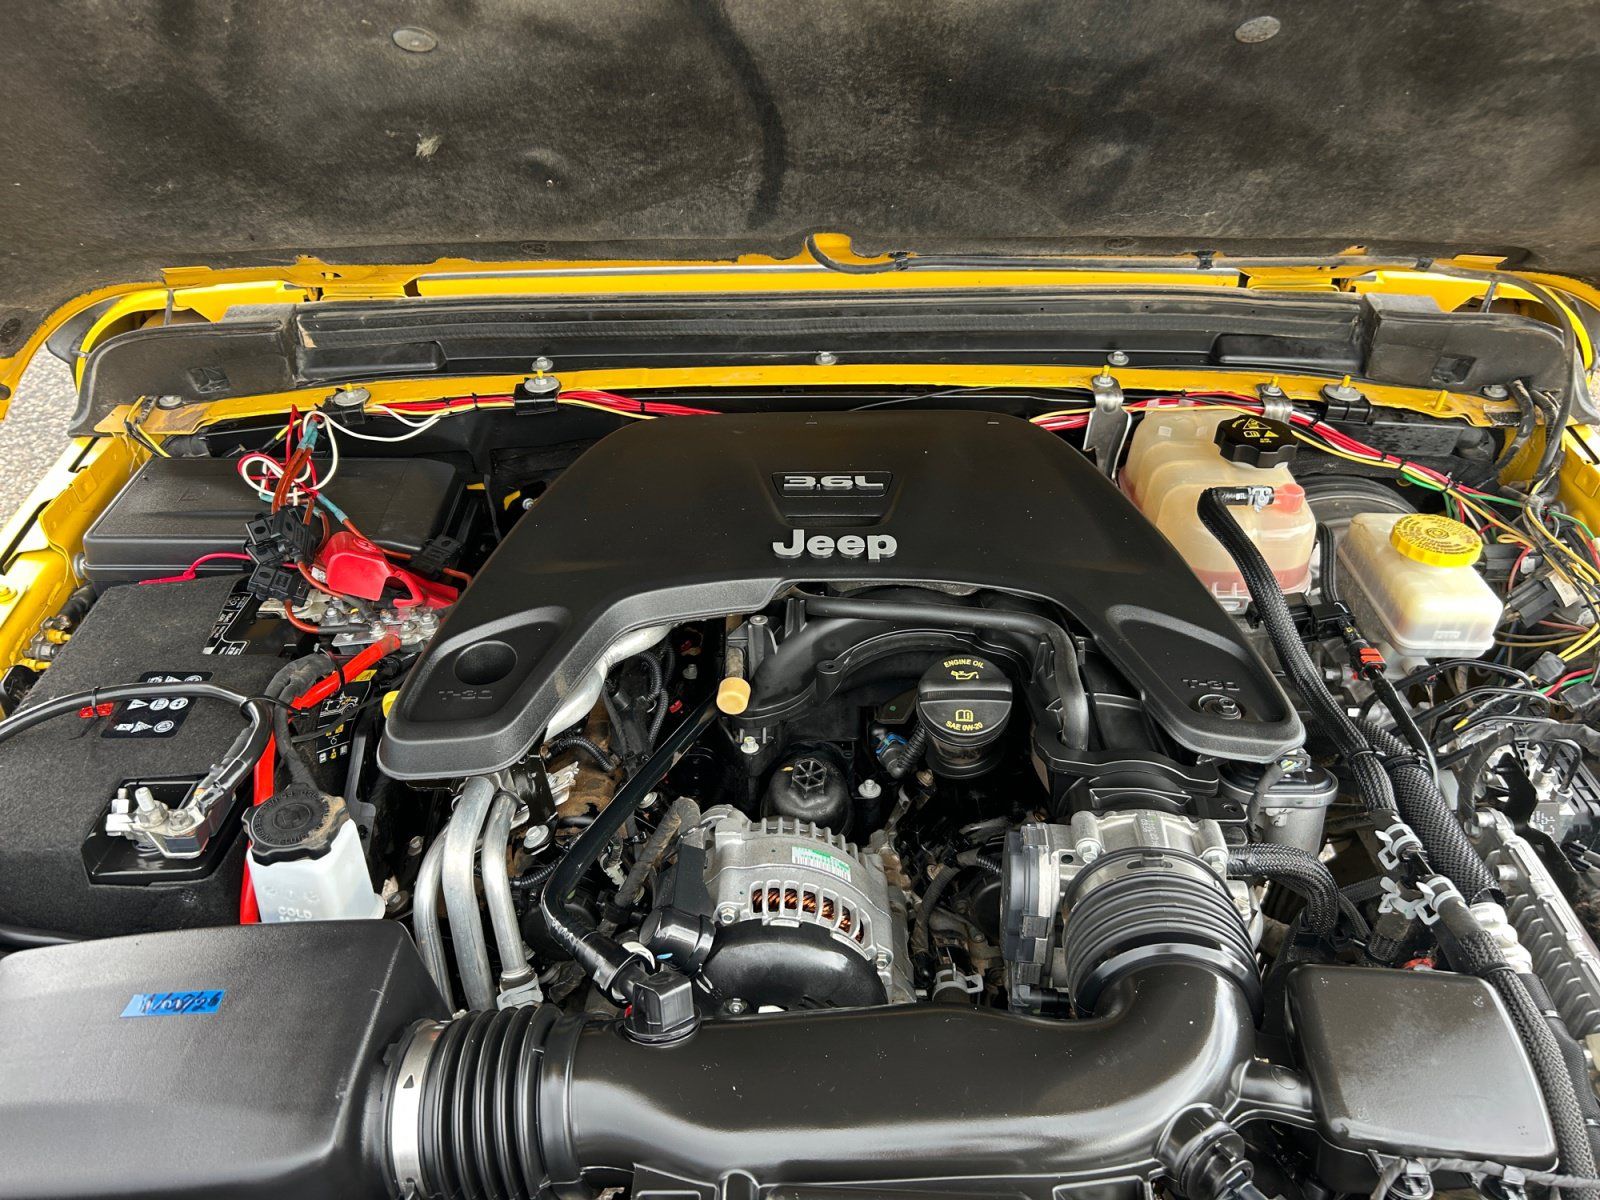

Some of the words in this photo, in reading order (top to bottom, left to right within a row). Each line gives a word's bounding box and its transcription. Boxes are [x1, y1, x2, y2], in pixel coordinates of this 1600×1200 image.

[783, 475, 884, 491] 3.6L
[772, 529, 898, 563] Jeep
[944, 659, 971, 668] ENGINE
[973, 660, 984, 669] OIL
[946, 721, 961, 730] SAE
[962, 722, 983, 731] 0W-20
[278, 906, 312, 919] COLD
